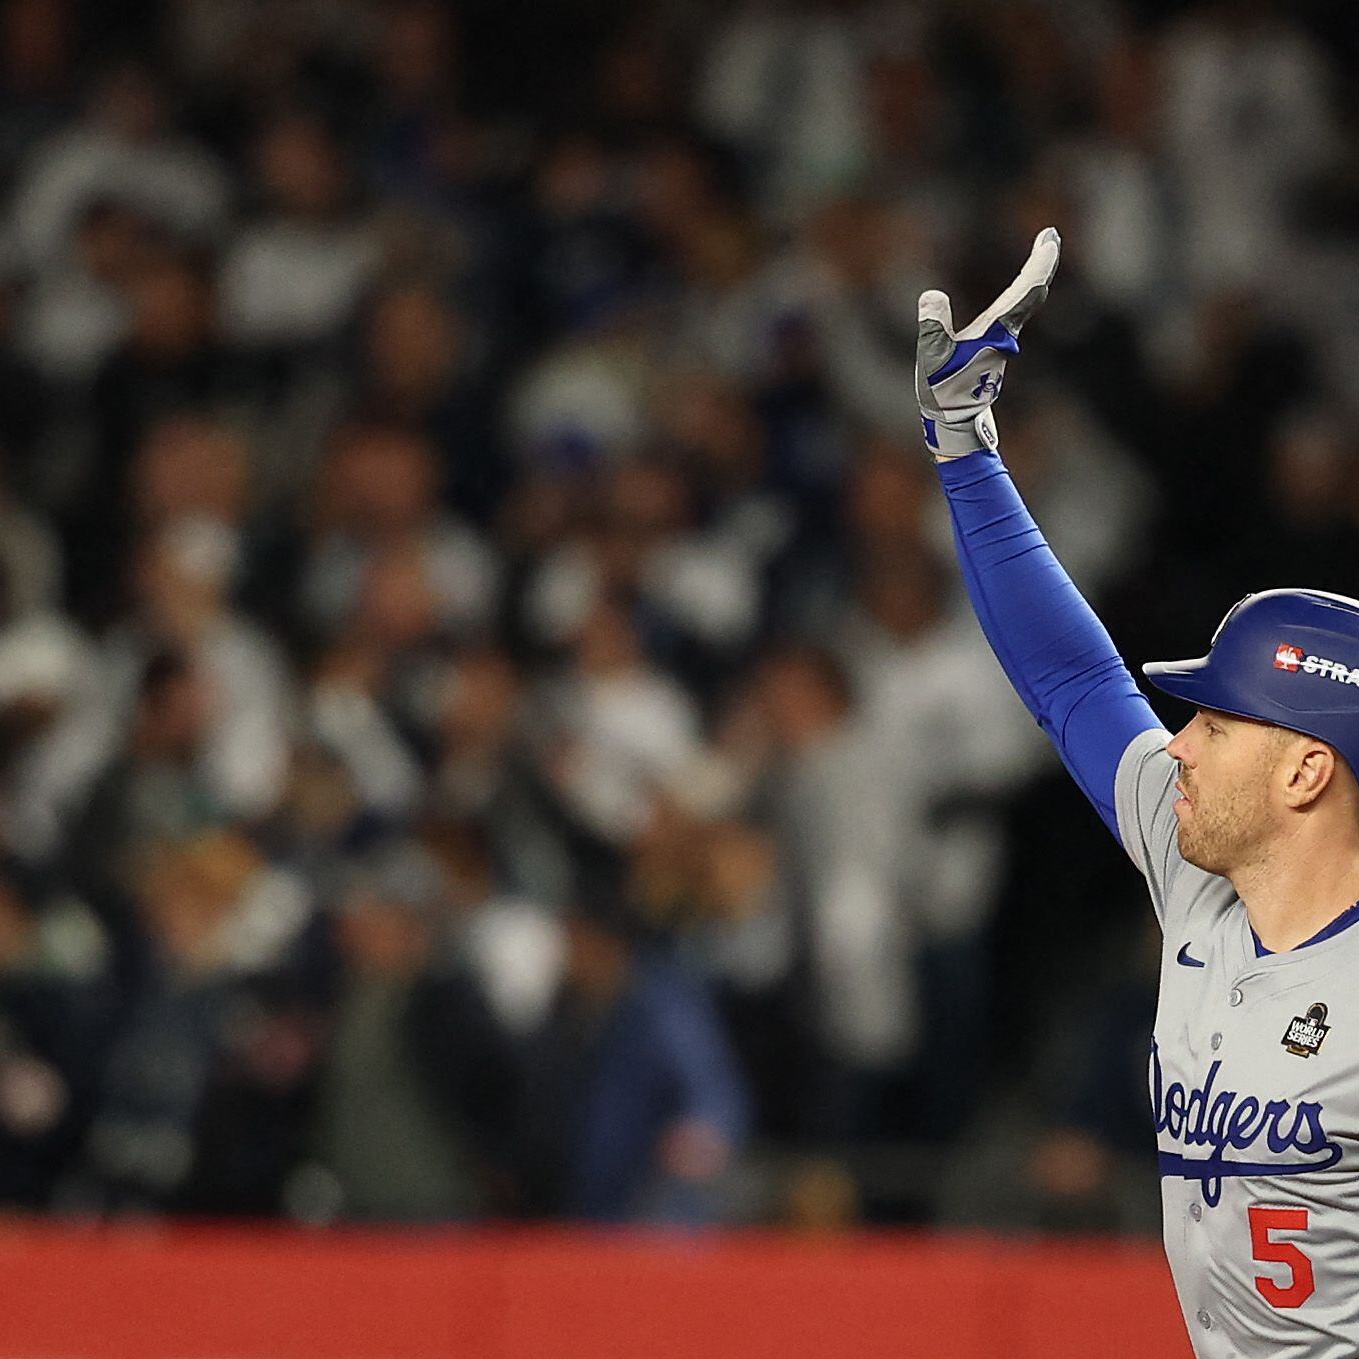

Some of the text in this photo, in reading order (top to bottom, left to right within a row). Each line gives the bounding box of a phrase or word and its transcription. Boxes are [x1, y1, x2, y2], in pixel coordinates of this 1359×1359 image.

[1291, 1020, 1325, 1039] WORLD
[1287, 1031, 1320, 1048] SERIES
[1247, 1207, 1316, 1309] 5
